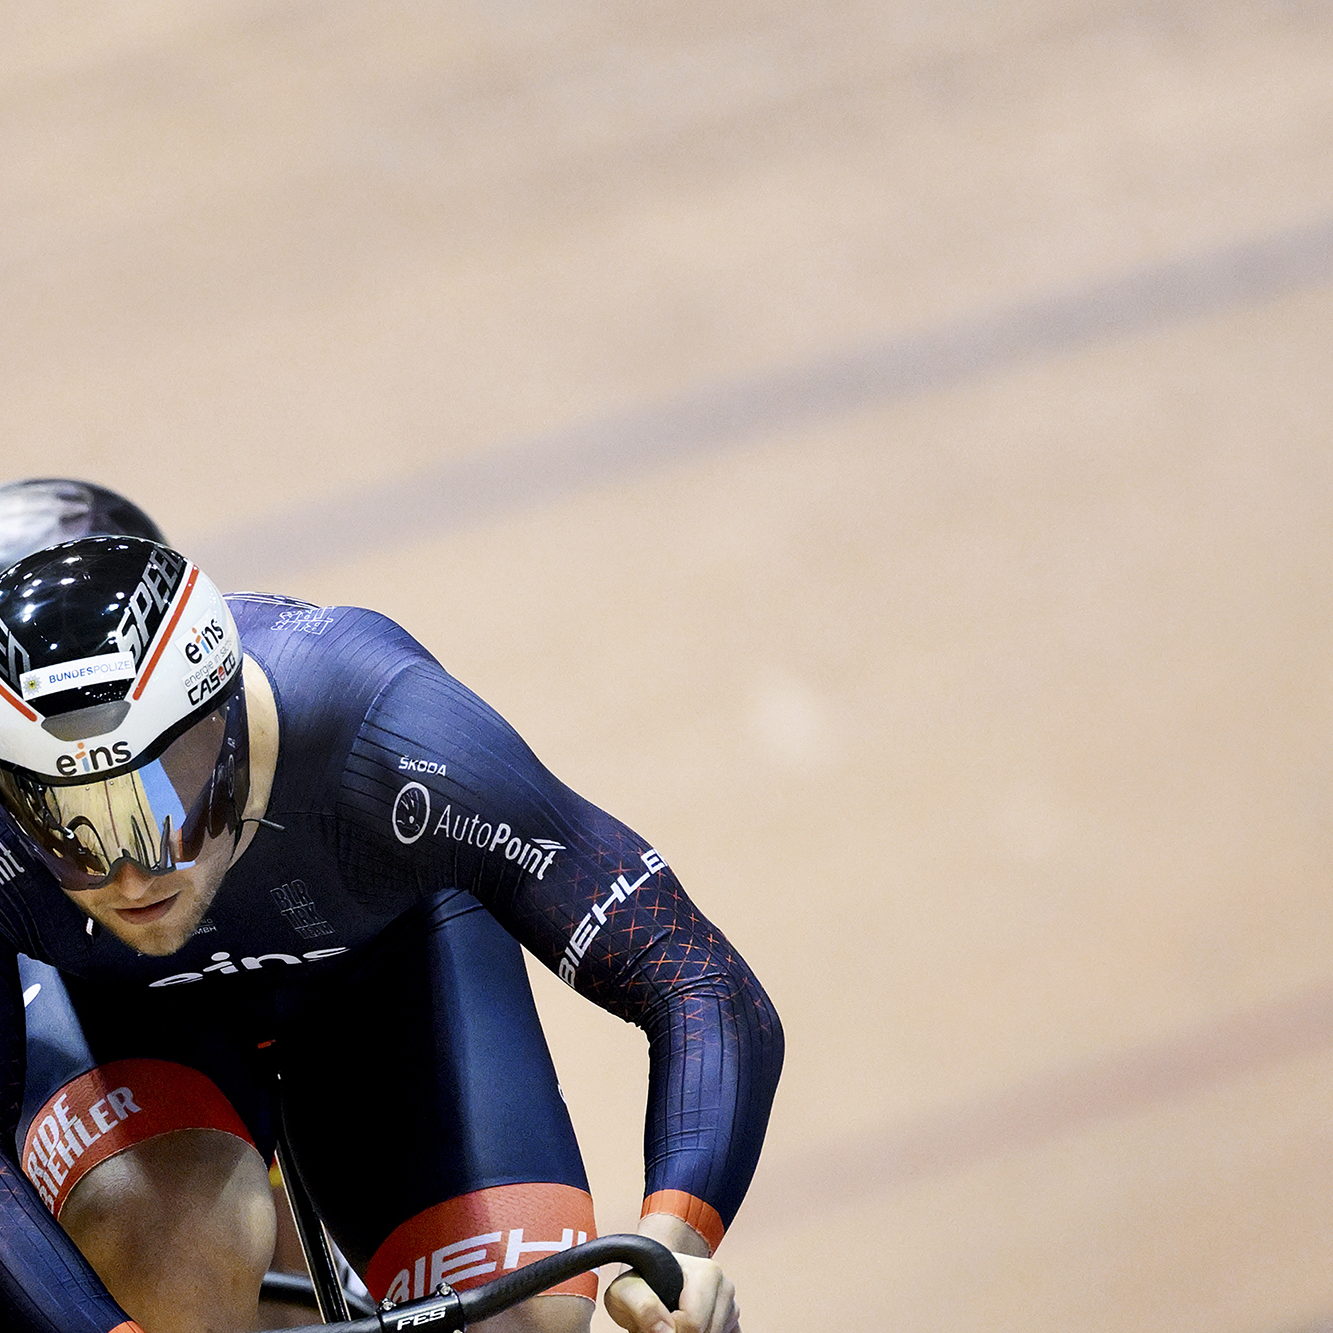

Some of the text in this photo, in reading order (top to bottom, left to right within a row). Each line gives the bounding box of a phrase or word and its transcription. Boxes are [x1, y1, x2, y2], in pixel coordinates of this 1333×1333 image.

[185, 618, 225, 664] eins
[49, 659, 134, 685] BUNDESPOLIZEI
[184, 658, 214, 688] energie
[55, 741, 132, 777] eins
[398, 756, 447, 777] ŠKODA
[433, 804, 559, 881] AutoPoint
[559, 848, 669, 989] BIEHLE
[27, 1093, 79, 1189] RIDE
[397, 1306, 447, 1331] FES
